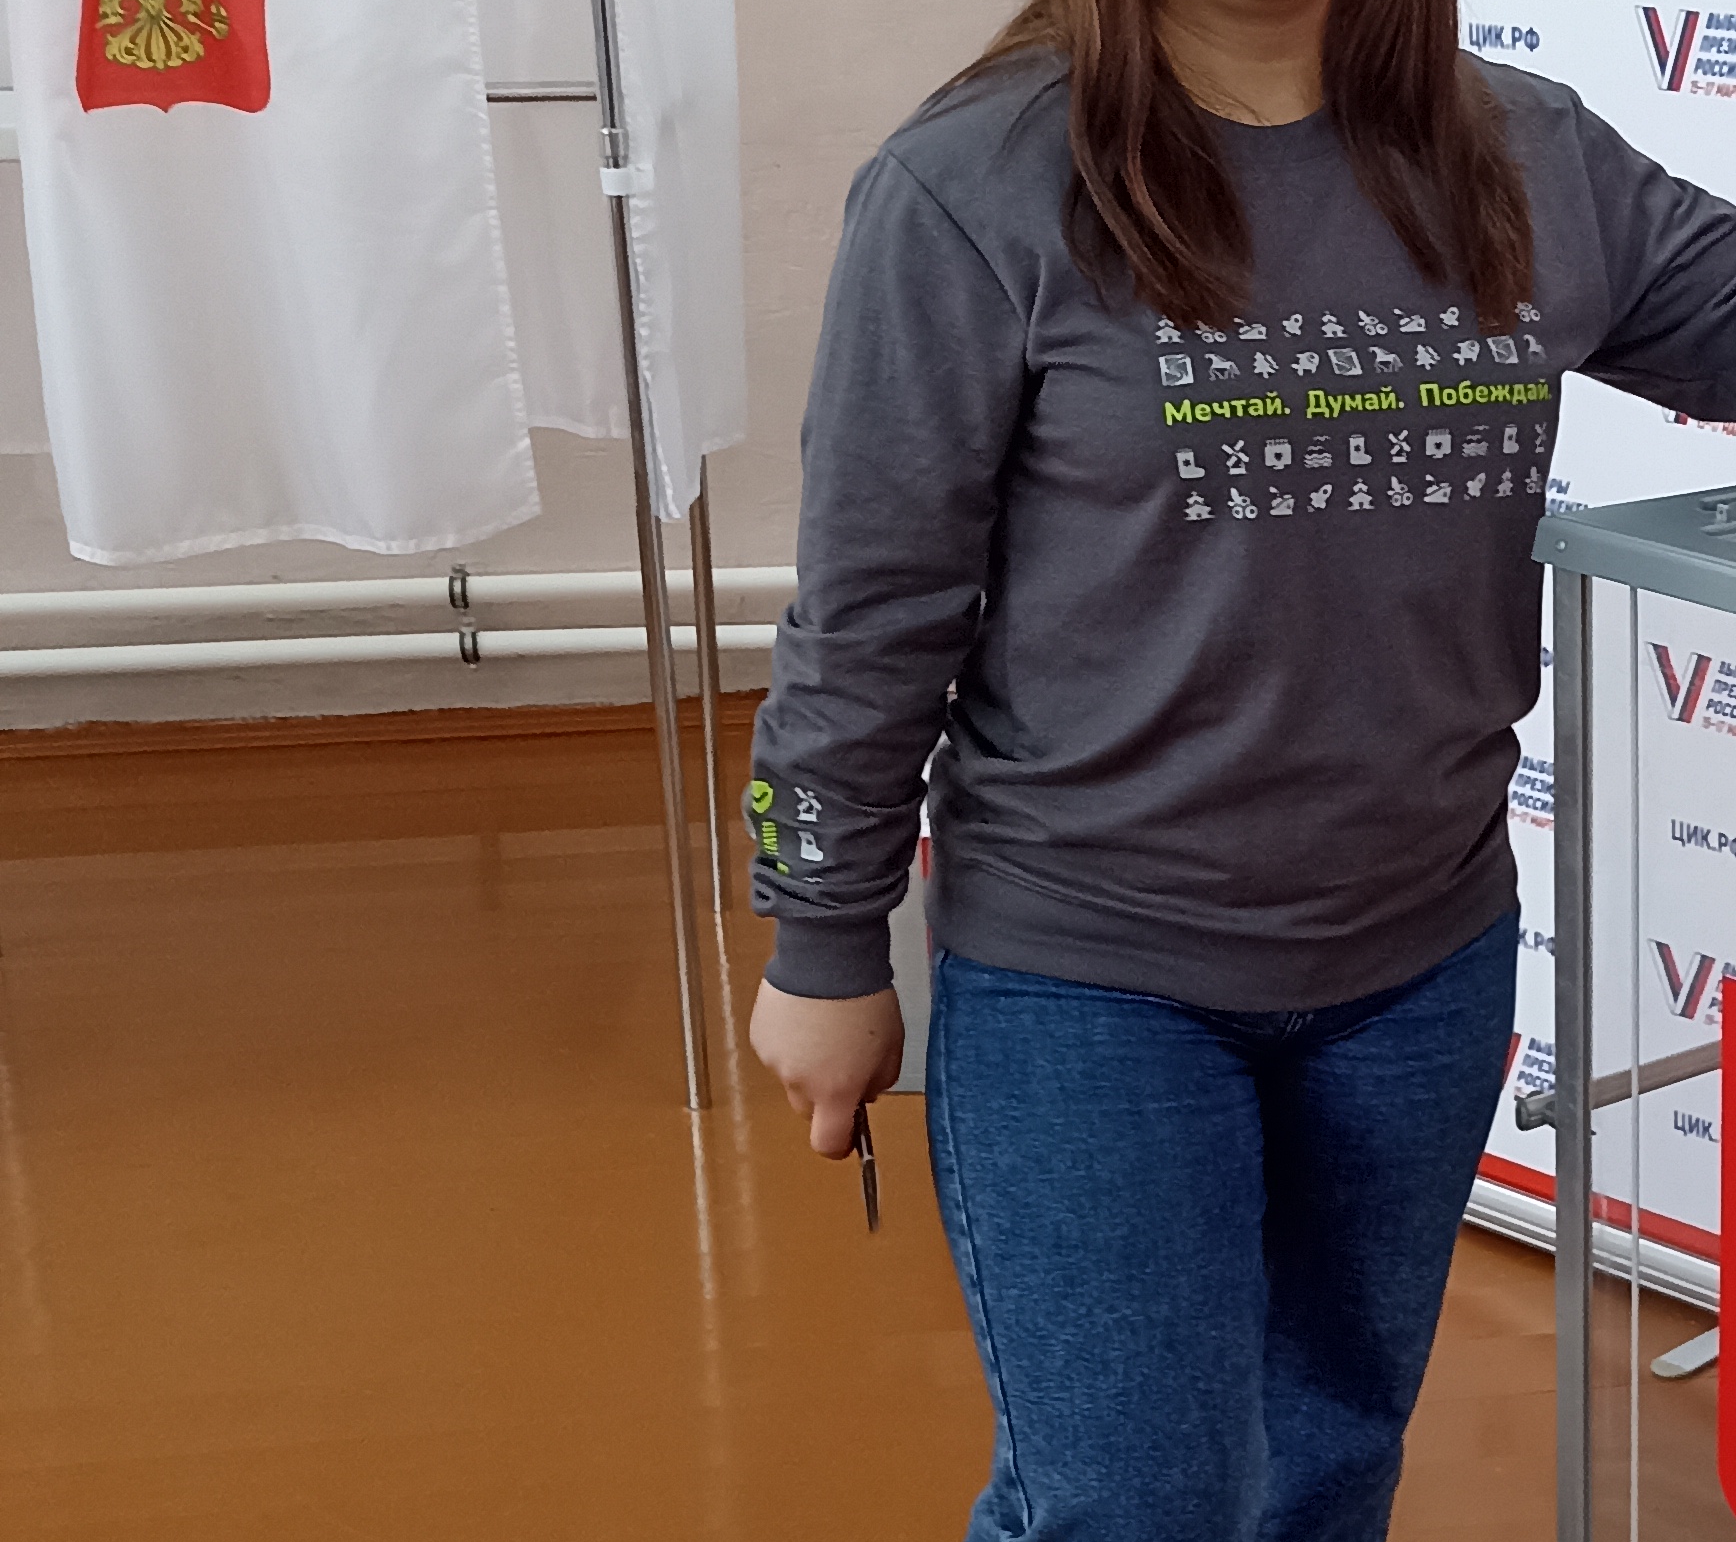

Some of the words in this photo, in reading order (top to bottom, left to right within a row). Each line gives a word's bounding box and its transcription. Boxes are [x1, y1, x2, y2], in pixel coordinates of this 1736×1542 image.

[1469, 22, 1540, 52] ЦИК.РФ
[1164, 392, 1291, 426] Мечтай.
[1305, 386, 1404, 419] Думай.
